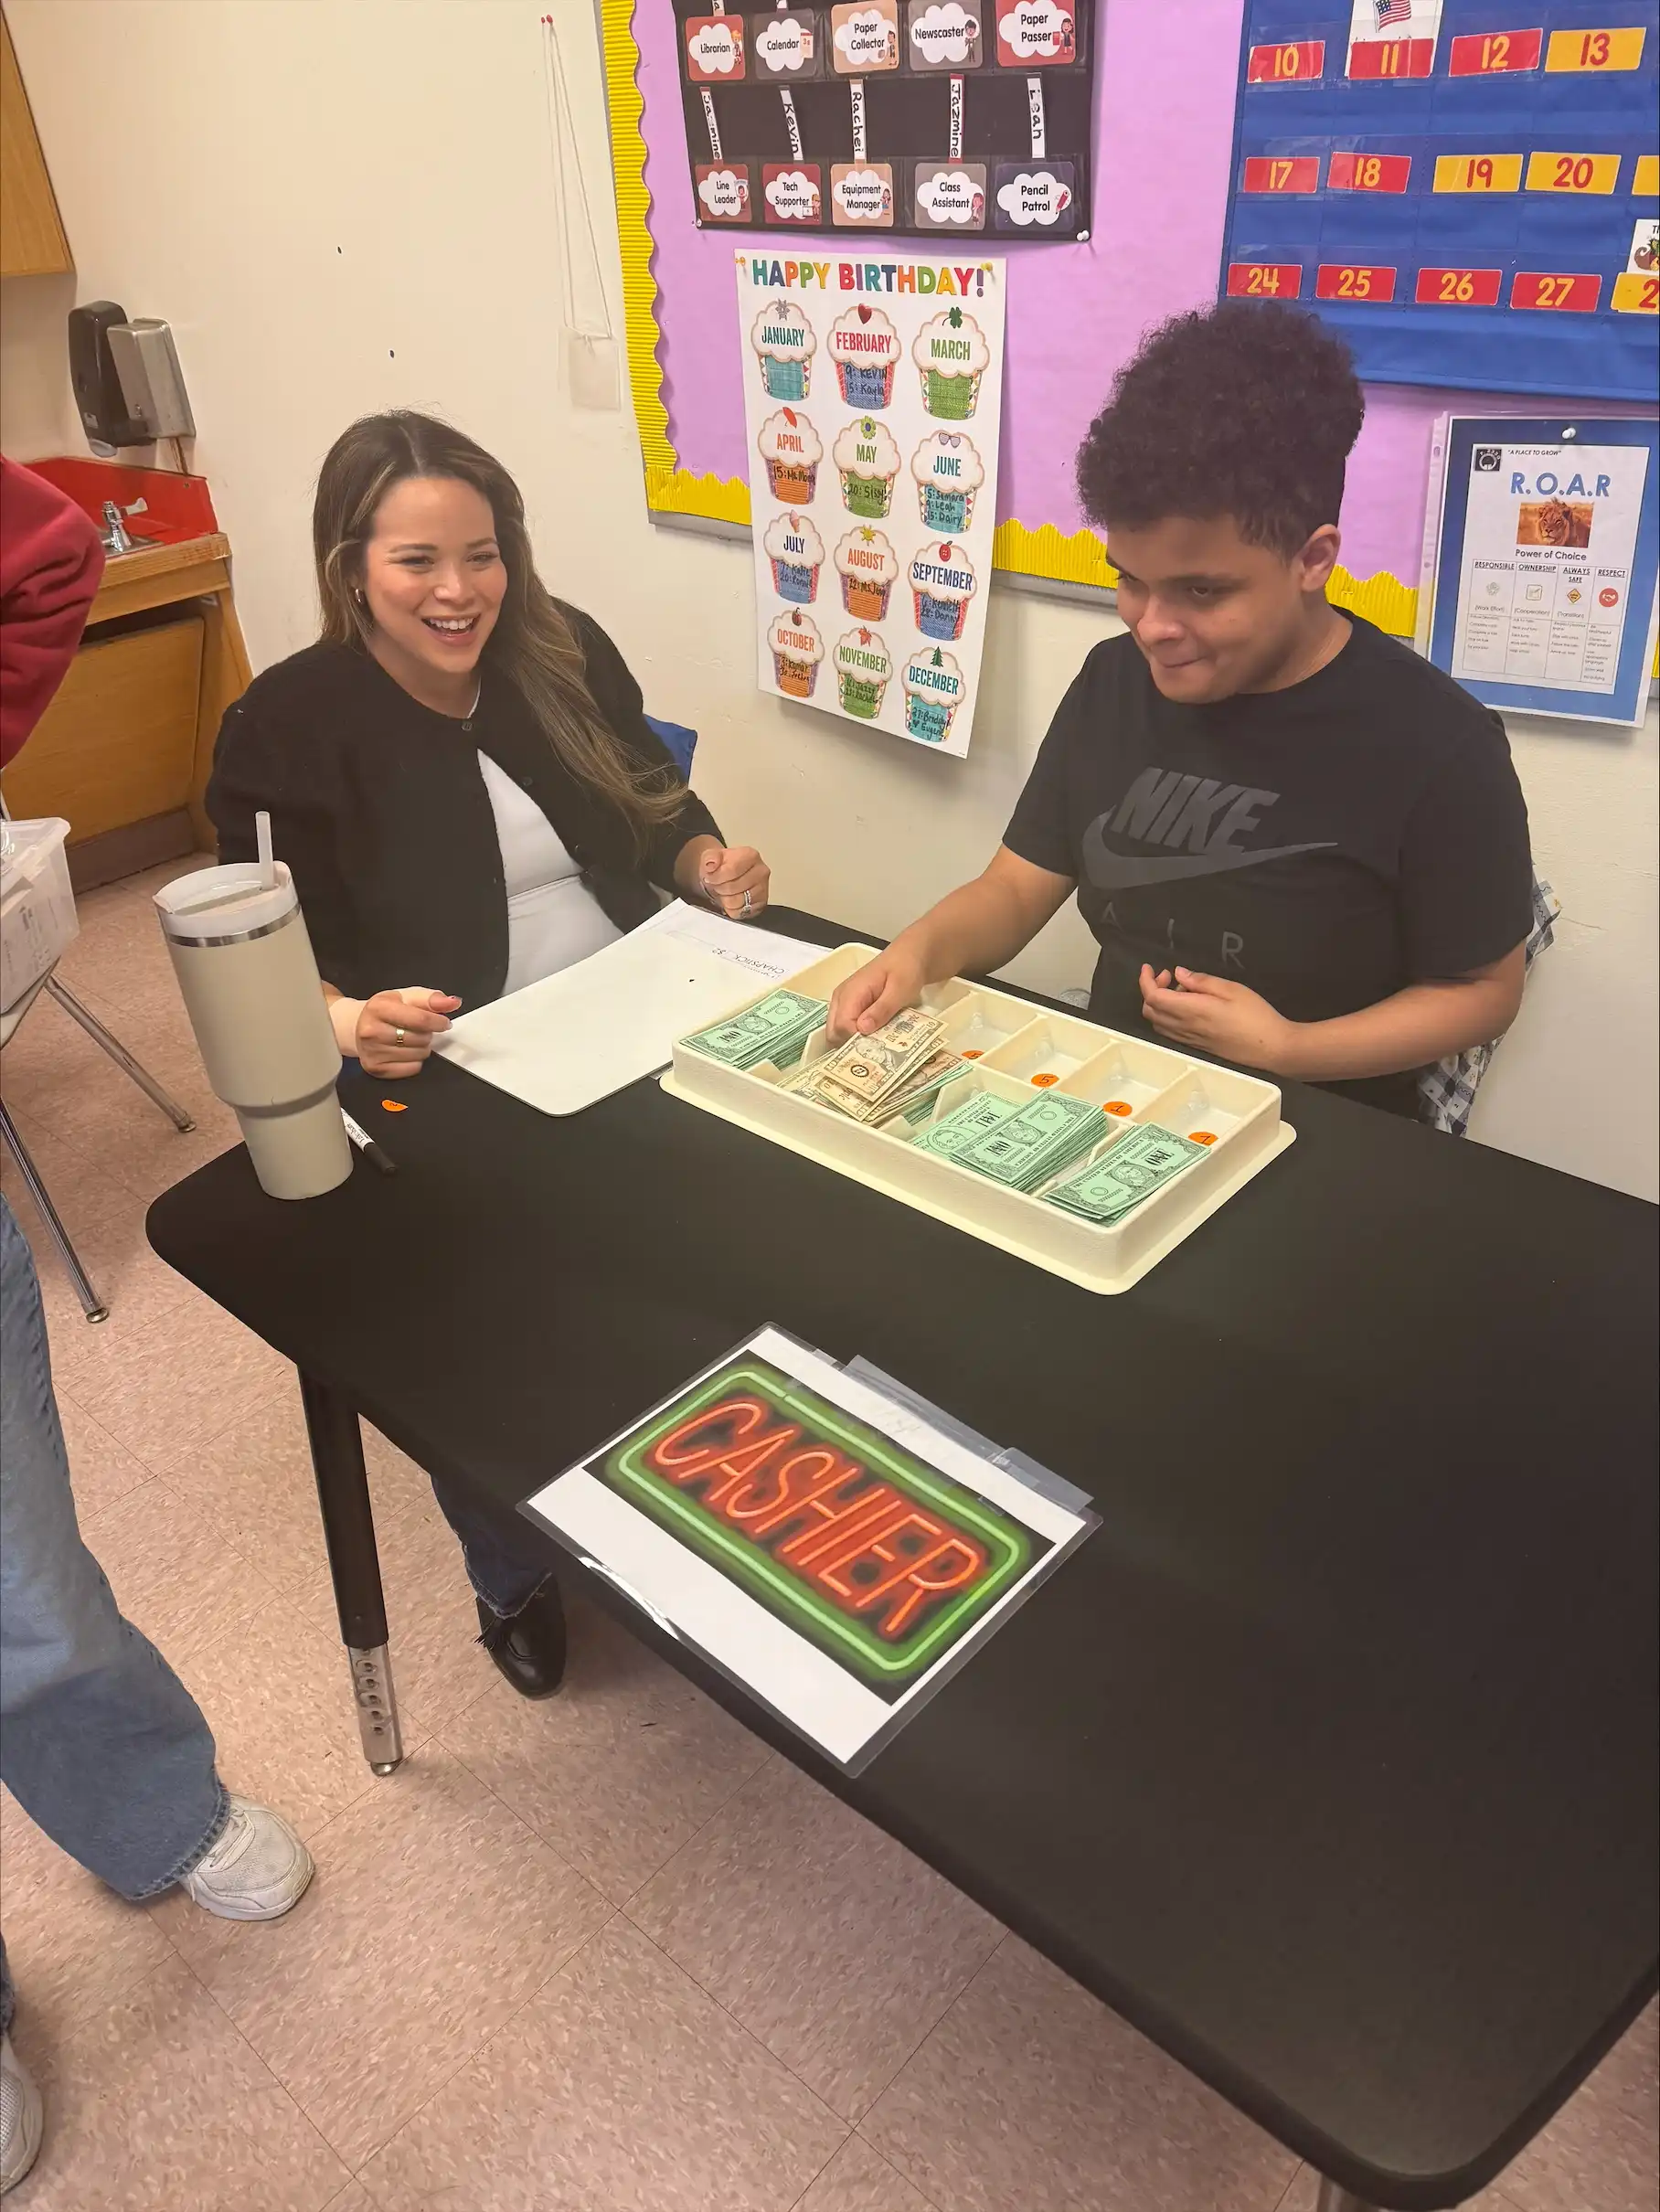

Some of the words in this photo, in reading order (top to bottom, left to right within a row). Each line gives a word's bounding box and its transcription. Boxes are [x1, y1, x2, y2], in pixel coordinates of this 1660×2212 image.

[854, 23, 878, 35] Paper
[1020, 14, 1048, 26] Paper
[850, 38, 885, 49] Collector
[915, 27, 965, 39] Newscaster
[1021, 31, 1052, 43] Passer
[700, 43, 731, 53] Librarian
[767, 39, 800, 51] Calendar
[1482, 36, 1510, 69] 12
[1580, 32, 1610, 66] 13
[1274, 46, 1299, 77] 10
[1381, 45, 1399, 75] 11
[784, 102, 799, 154] Kevin
[951, 83, 962, 157] Jazmine
[1269, 161, 1294, 188] 17
[1356, 157, 1381, 186] 18
[1467, 159, 1494, 188] 19
[1553, 157, 1594, 188] 20
[716, 181, 729, 190] Line
[782, 182, 799, 192] Tech
[842, 185, 881, 197] Equipment
[940, 182, 961, 192] Class
[1021, 185, 1048, 196] Pencil
[715, 195, 737, 205] Leader
[774, 197, 810, 208] Supporter
[846, 199, 881, 210] Manager
[931, 198, 970, 208] Assistant
[1022, 201, 1050, 212] Patrol
[752, 260, 831, 289] HAPPY
[838, 263, 985, 298] BIRTHDAY!
[1248, 267, 1280, 294] 24
[1338, 271, 1371, 298] 25
[1439, 272, 1474, 301] 26
[1535, 278, 1576, 307] 27
[1638, 280, 1659, 309] 2
[761, 325, 804, 347] JANUARY
[835, 331, 892, 355] FEBRUARY
[931, 338, 972, 360] MARCH
[777, 433, 804, 453] APRIL
[856, 444, 878, 464] MAY
[932, 455, 962, 477] JUNE
[936, 501, 955, 512] Leah
[782, 535, 805, 554] JULY
[1515, 549, 1543, 559] Power
[1544, 550, 1553, 559] of
[1554, 550, 1587, 561] Choice
[846, 548, 886, 571] AUGUST
[1474, 561, 1515, 570] RESPONSIBLE
[1517, 564, 1557, 572] OWNERSHIP
[912, 561, 973, 591] SEPTEMBER
[1563, 567, 1591, 576] ALWAYS
[1597, 569, 1625, 578] RESPECT
[777, 629, 815, 653] OCTOBER
[839, 645, 887, 674] NOVEMBER
[909, 665, 960, 697] DECEMBER
[1109, 766, 1282, 855] NIKE
[1099, 901, 1247, 971] AIR
[1038, 1075, 1054, 1084] 5
[1110, 1104, 1124, 1113] 1
[654, 1401, 982, 1632] CASHIER
